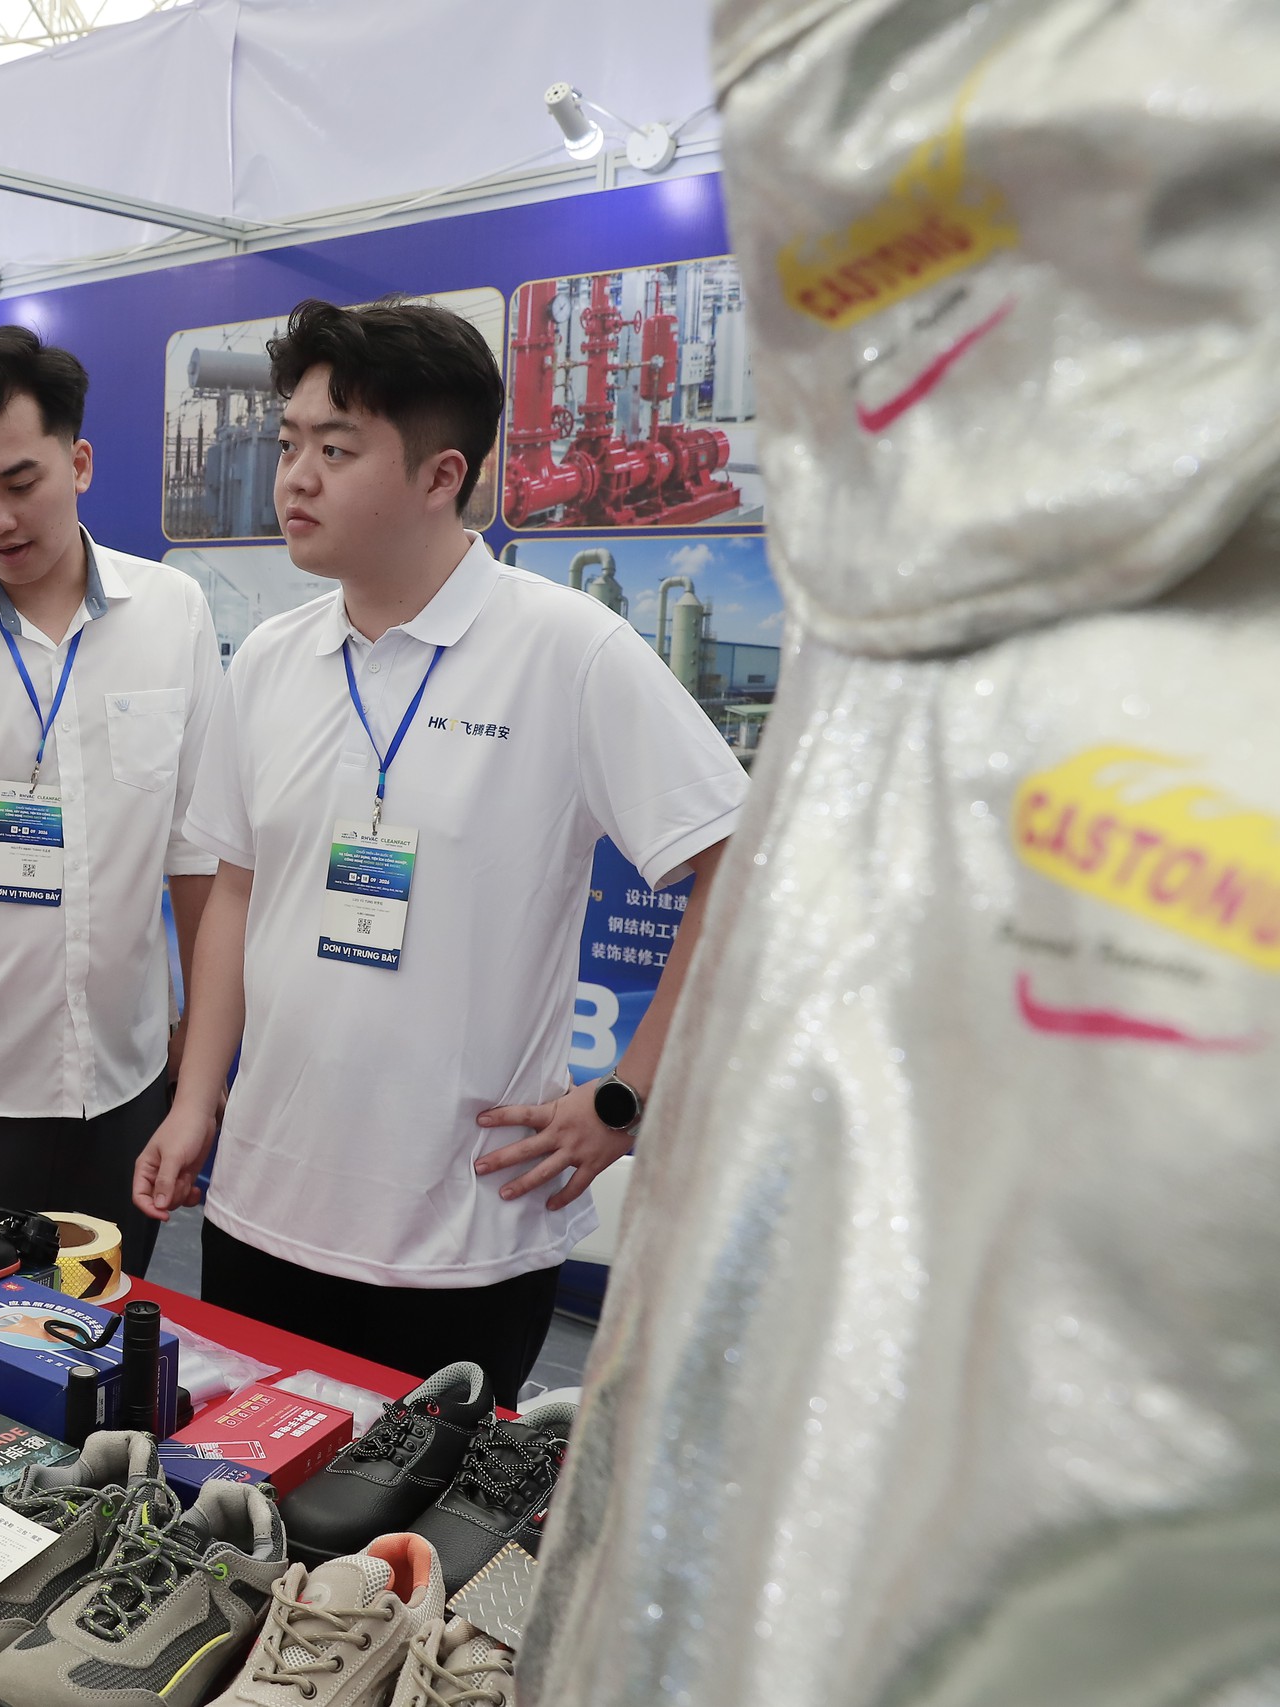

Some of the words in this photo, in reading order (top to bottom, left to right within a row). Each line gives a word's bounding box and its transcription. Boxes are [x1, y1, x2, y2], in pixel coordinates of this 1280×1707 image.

[428, 716, 459, 732] HKT
[460, 720, 510, 740] 飞腾君安
[9, 889, 17, 899] VỊ
[45, 891, 60, 901] BÀY
[625, 888, 688, 912] 设计建造
[343, 946, 352, 958] VỊ
[381, 951, 398, 963] BÀY
